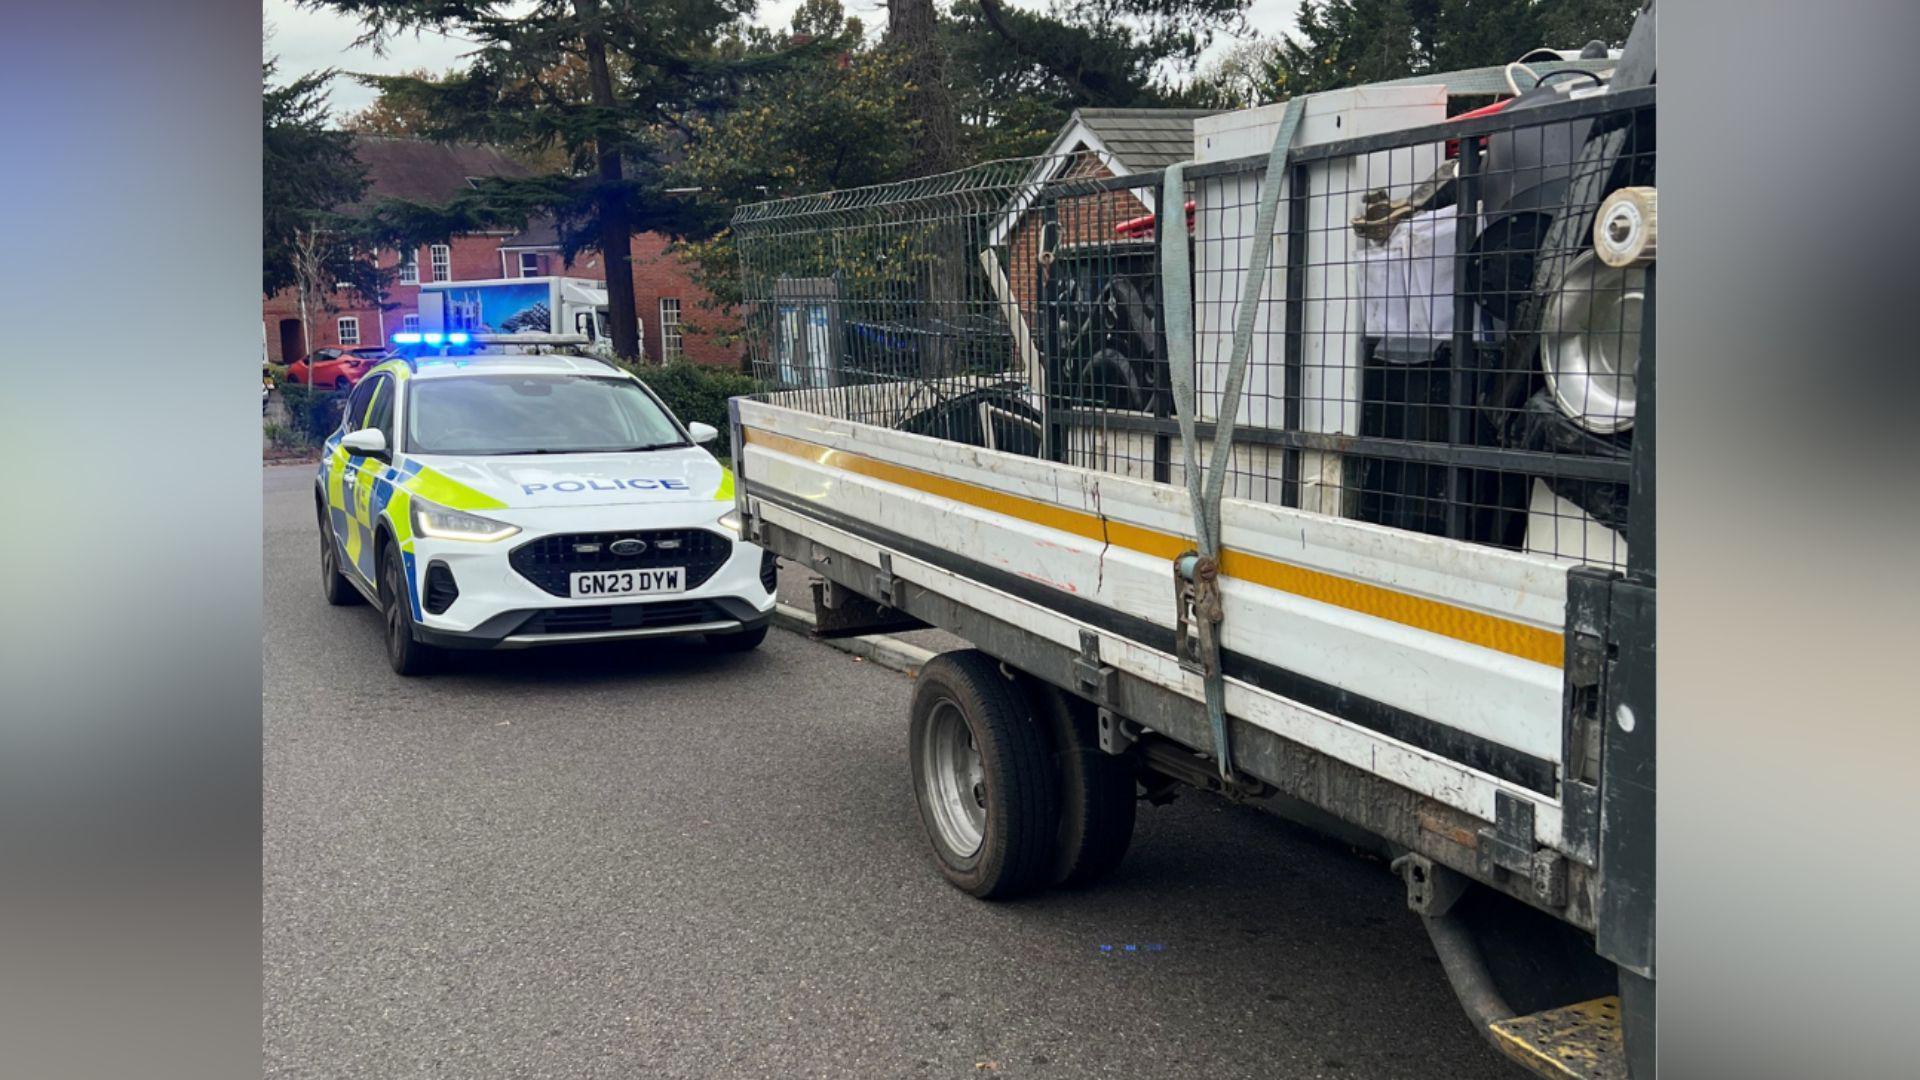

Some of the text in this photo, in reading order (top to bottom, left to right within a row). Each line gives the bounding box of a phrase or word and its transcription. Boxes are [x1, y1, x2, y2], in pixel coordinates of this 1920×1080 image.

[521, 478, 690, 495] POLICE
[578, 571, 678, 594] GN23 DYW
